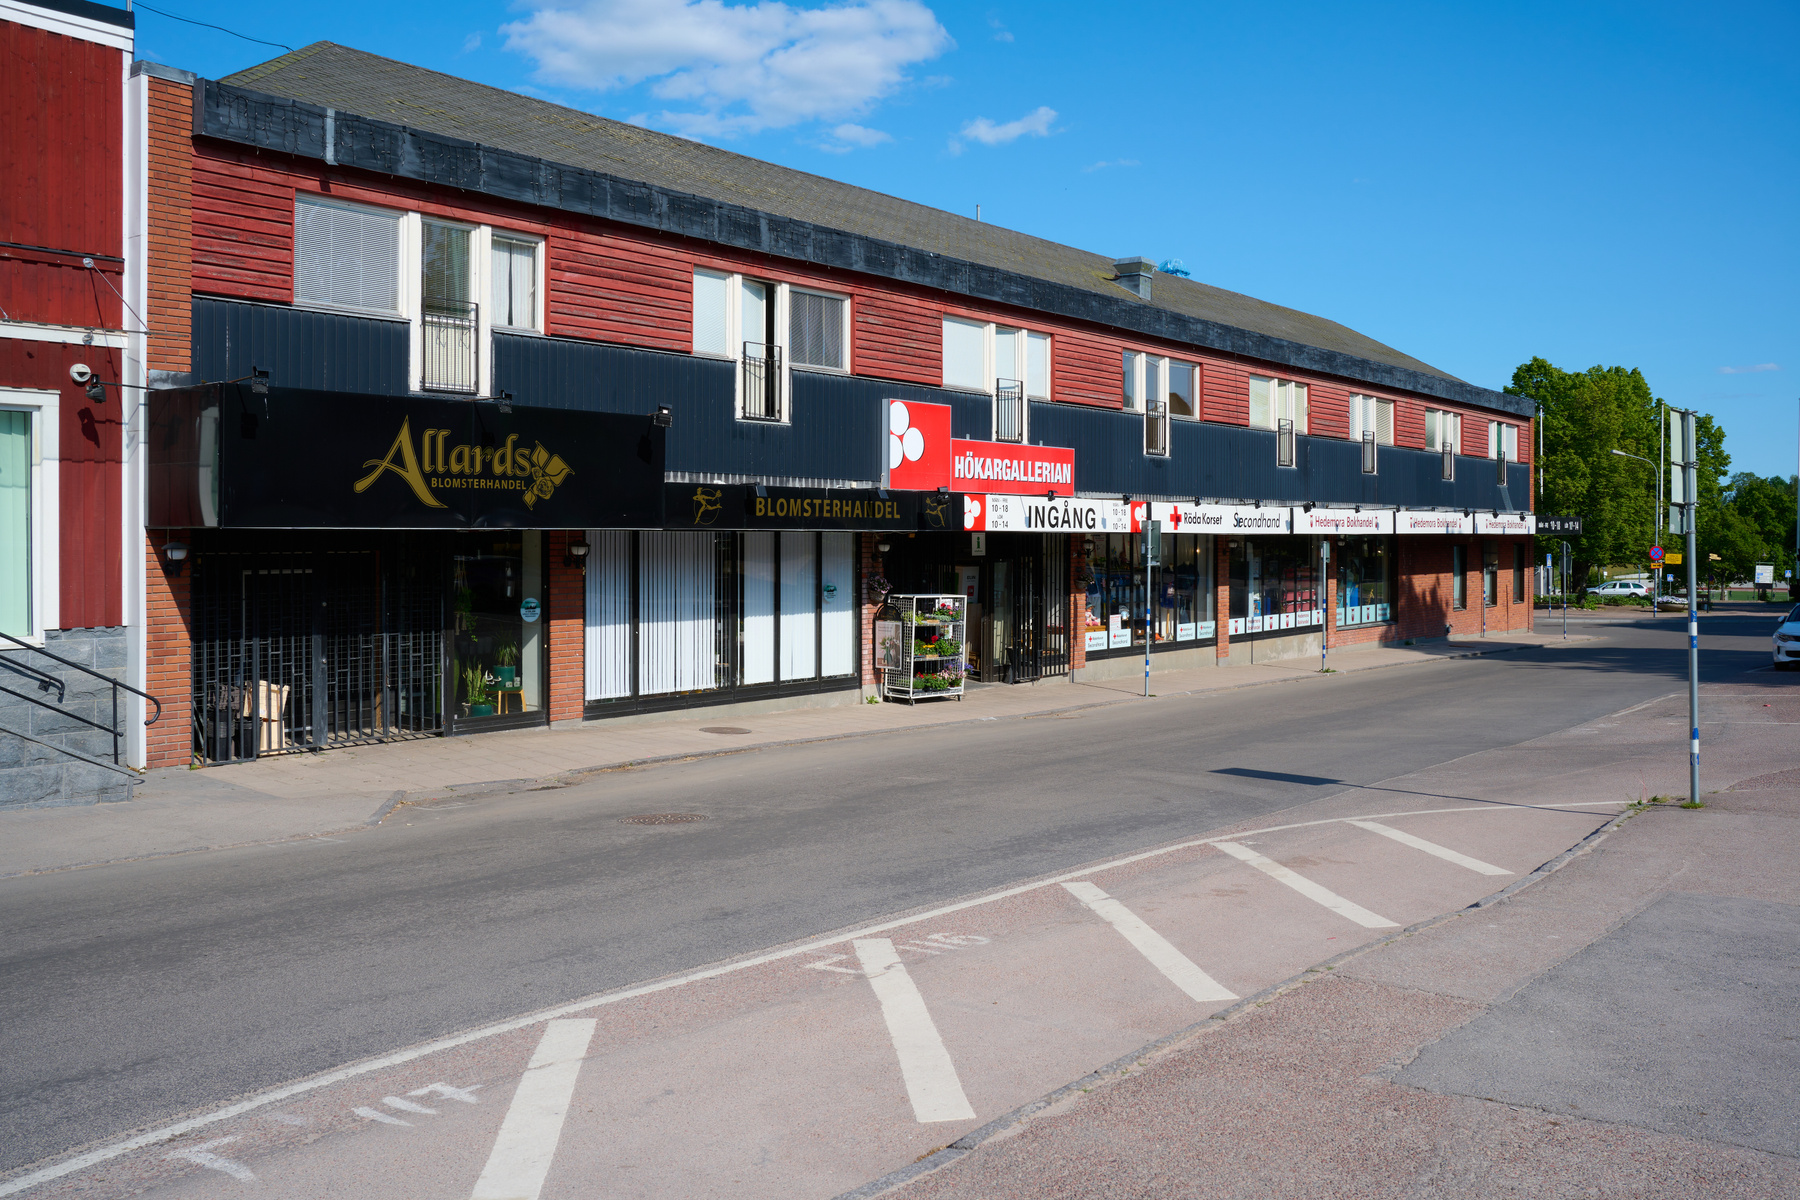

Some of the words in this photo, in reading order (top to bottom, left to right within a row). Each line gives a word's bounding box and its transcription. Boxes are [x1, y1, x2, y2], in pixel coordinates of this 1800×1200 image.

[353, 414, 532, 509] Allards
[954, 451, 1072, 484] HÖKARGALLERIAN
[431, 477, 527, 490] BLOMSTERHANDEL
[755, 497, 901, 519] BLOMSTERHANDEL
[1028, 500, 1097, 530] INGÅNG
[1183, 512, 1201, 525] Röda
[1202, 513, 1222, 525] Korset
[1233, 512, 1281, 528] Secondhand
[1315, 515, 1345, 528] Hedemora
[1346, 516, 1374, 528] Bokhandel
[1413, 517, 1436, 528] Hedemora
[1437, 518, 1458, 528] Bokhandel
